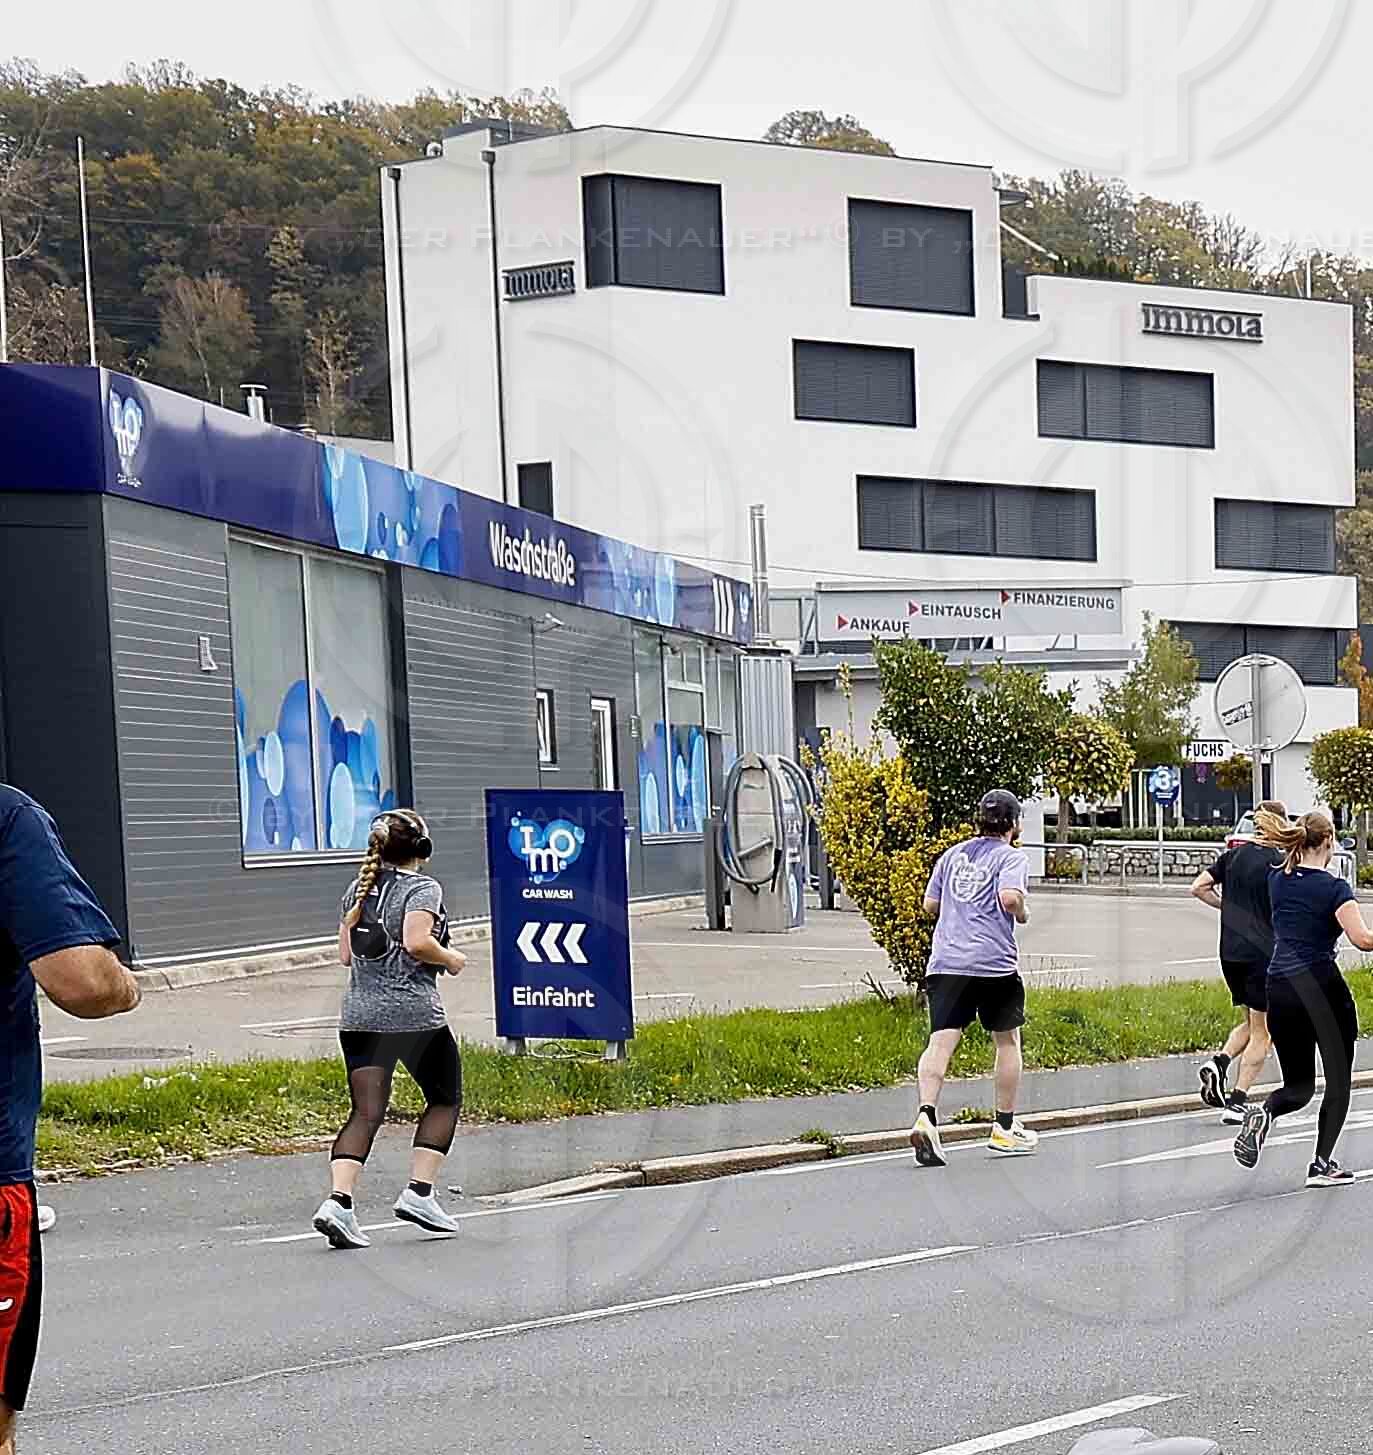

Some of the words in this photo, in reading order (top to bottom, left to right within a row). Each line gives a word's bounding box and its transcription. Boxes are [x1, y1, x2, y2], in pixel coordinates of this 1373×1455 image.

[488, 520, 577, 587] Waschstraße
[1013, 591, 1116, 610] FINANZIERUNG
[921, 604, 1001, 620] EINTAUSCH
[849, 617, 911, 634] ANKAUF
[1186, 743, 1224, 757] FUCHS
[522, 889, 543, 899] CAR
[543, 889, 574, 899] WASH
[512, 985, 595, 1008] Einfahrt
